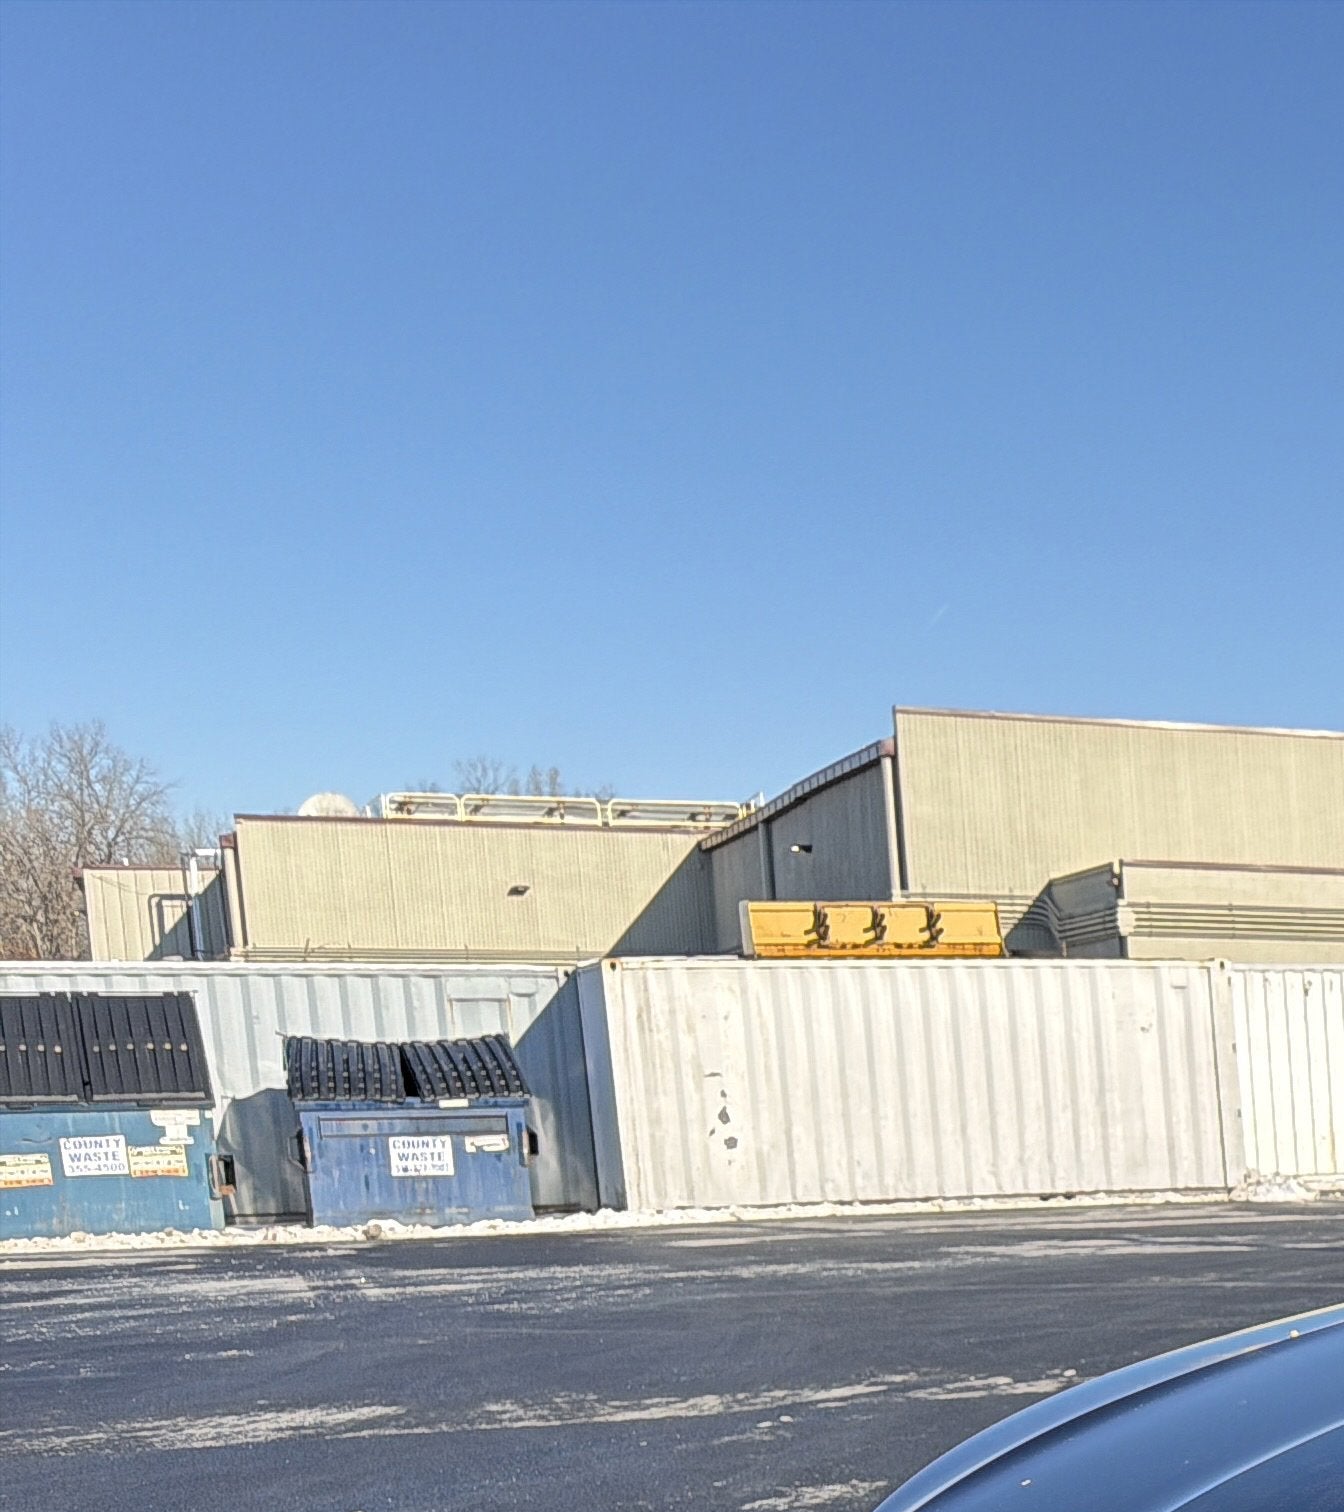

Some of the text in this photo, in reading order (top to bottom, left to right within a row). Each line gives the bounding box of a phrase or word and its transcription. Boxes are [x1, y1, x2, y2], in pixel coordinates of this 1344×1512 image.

[63, 1138, 121, 1150] COUNTY
[392, 1139, 447, 1150] COUNTY
[68, 1150, 121, 1163] WASTE
[397, 1151, 445, 1162] WASTE
